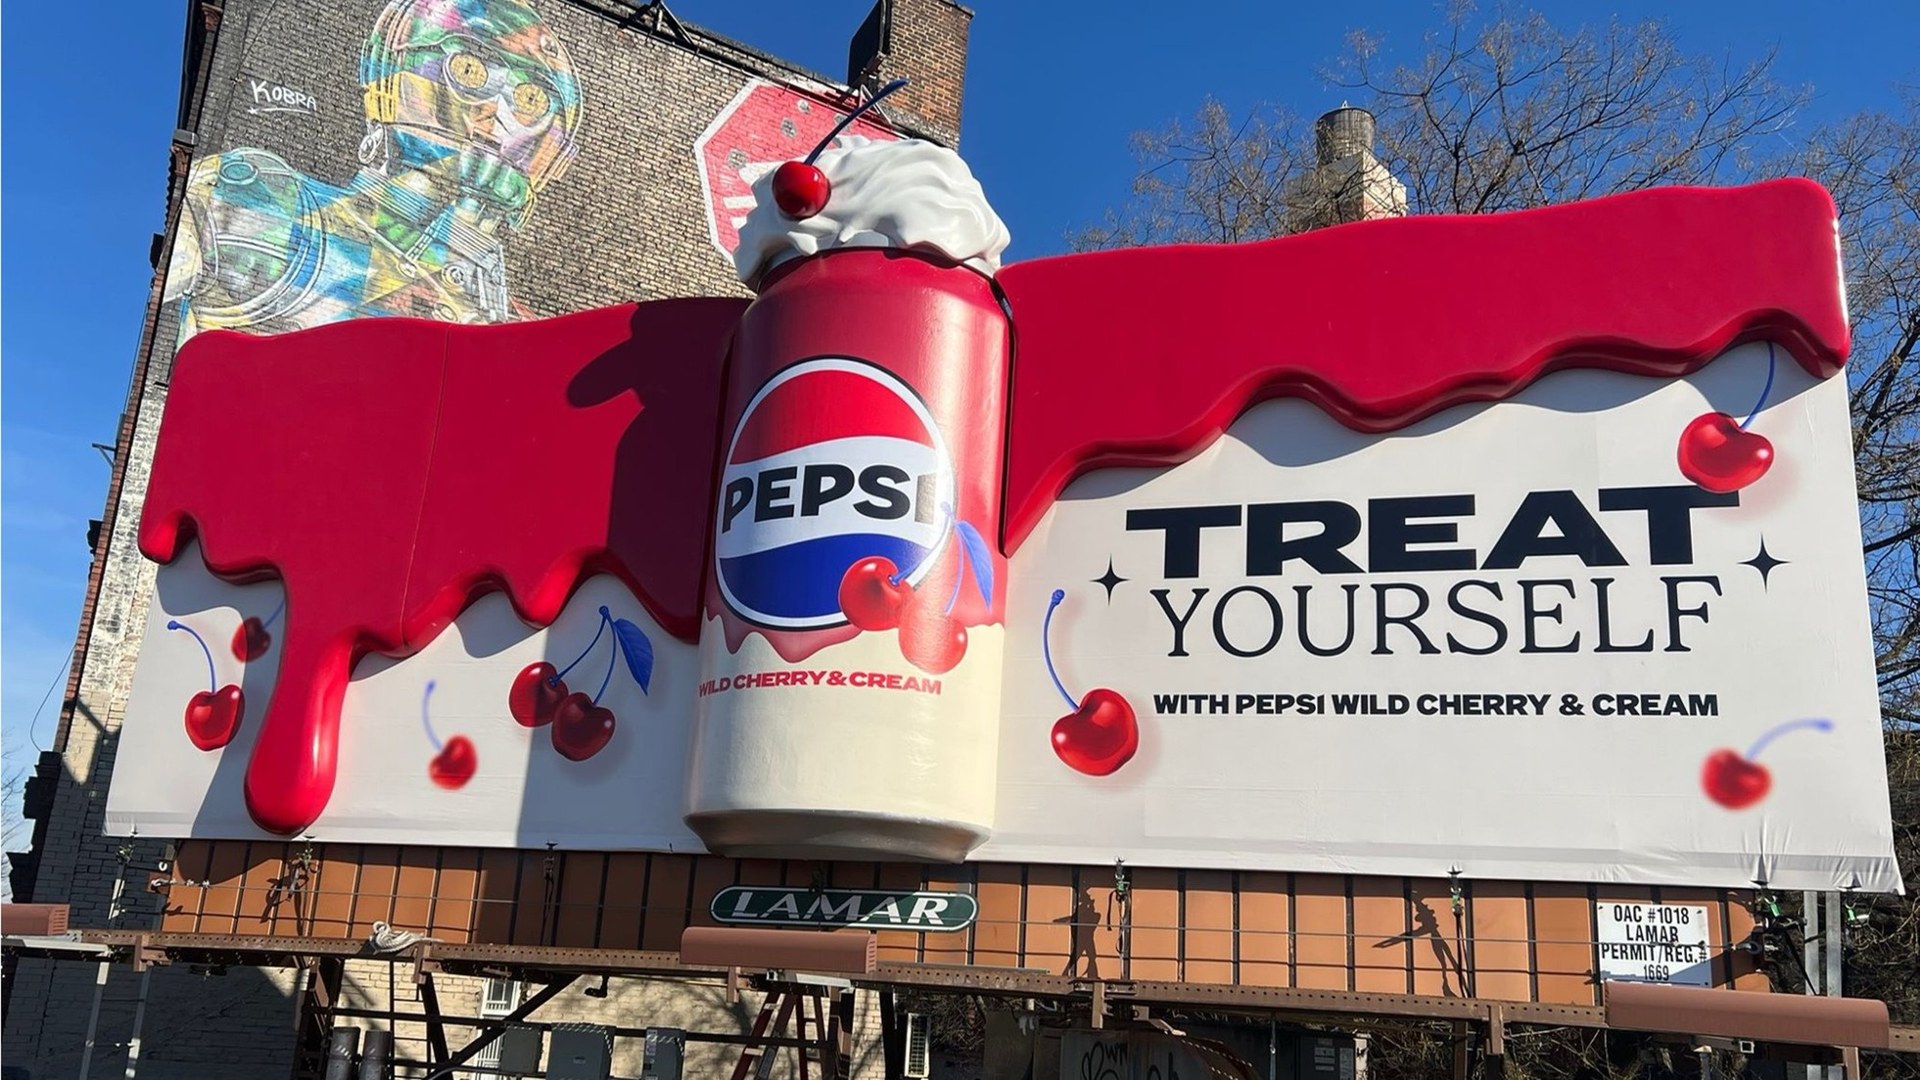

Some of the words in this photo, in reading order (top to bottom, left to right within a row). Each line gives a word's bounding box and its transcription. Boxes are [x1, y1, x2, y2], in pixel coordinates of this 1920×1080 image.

[250, 80, 317, 111] KOBRA
[722, 463, 937, 534] PEPSI
[1126, 485, 1740, 579] TREAT
[1150, 575, 1722, 658] YOURSELF
[1154, 694, 1230, 714] WITH
[1235, 694, 1325, 715] PEPSI
[1332, 694, 1410, 715] WILD
[1416, 694, 1551, 716] CHERRY
[1558, 694, 1586, 716] &
[1591, 694, 1719, 717] CREAM
[731, 891, 948, 925] LAMAR
[1613, 904, 1643, 923] OAC
[1647, 906, 1690, 925] #1018
[1626, 924, 1679, 943] LAMAR
[1643, 964, 1670, 981] 1669
